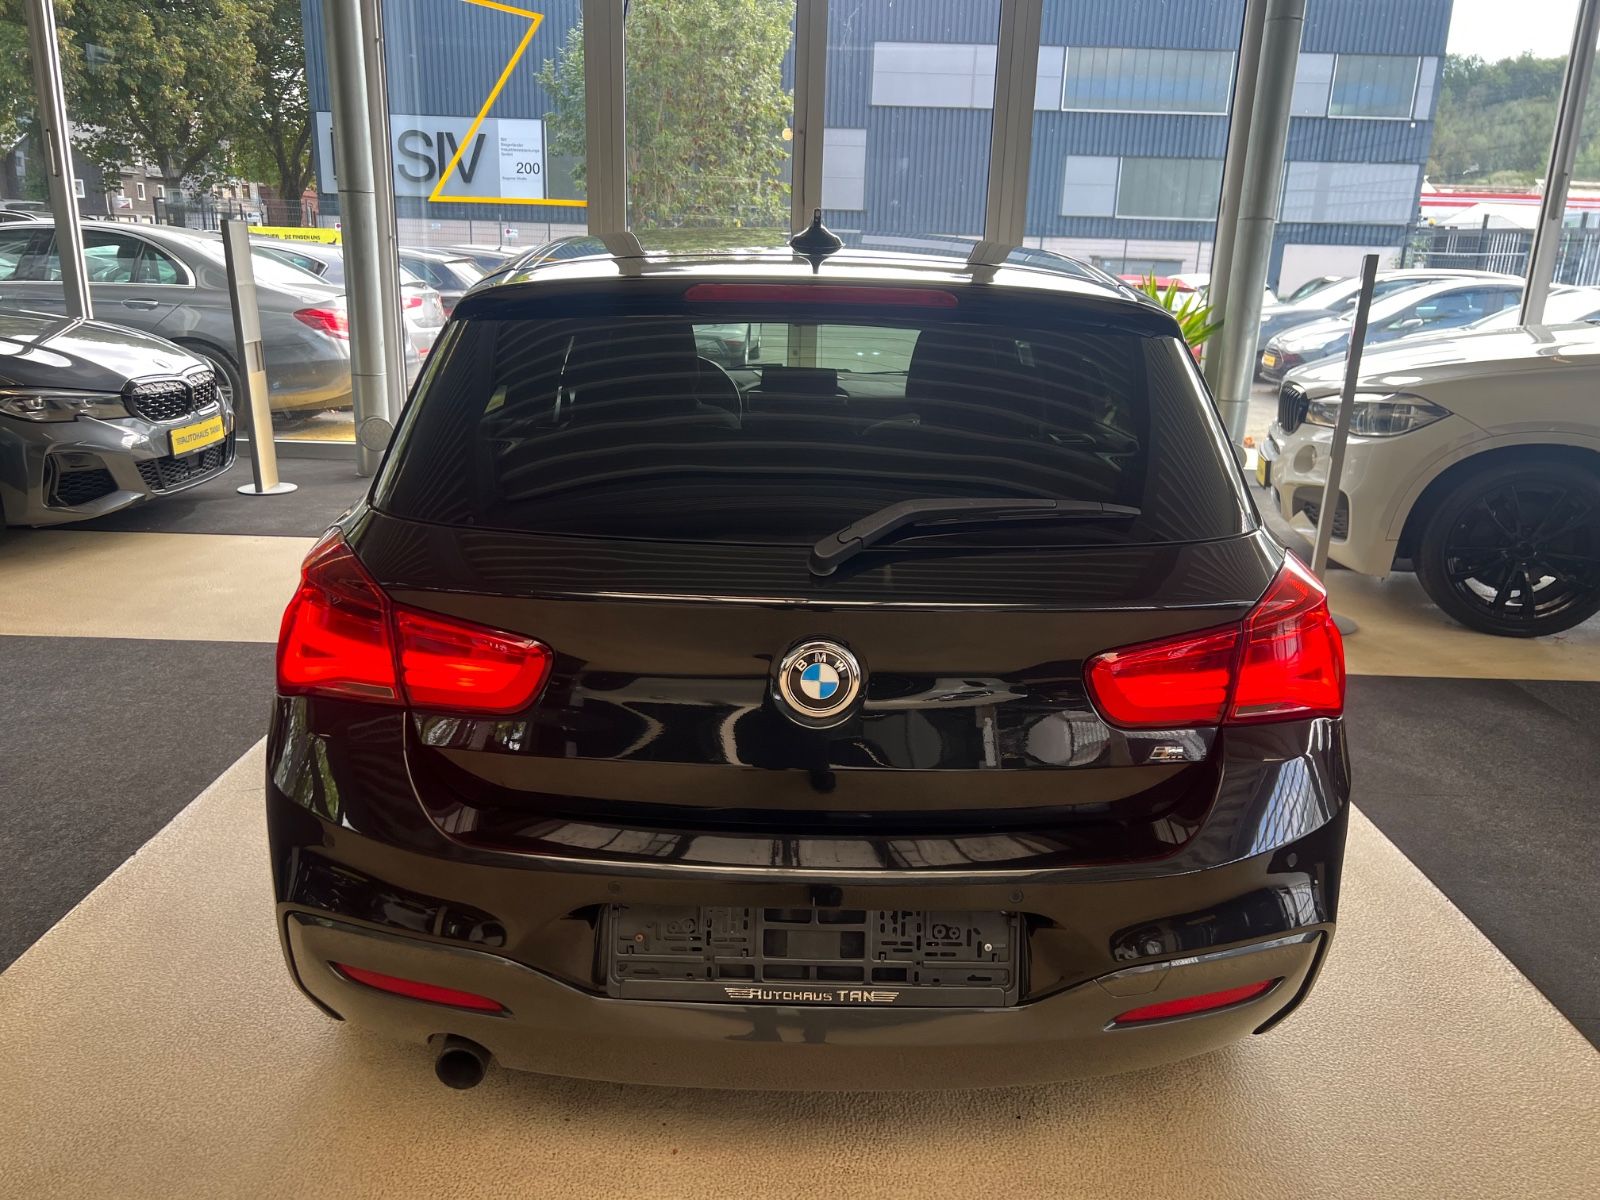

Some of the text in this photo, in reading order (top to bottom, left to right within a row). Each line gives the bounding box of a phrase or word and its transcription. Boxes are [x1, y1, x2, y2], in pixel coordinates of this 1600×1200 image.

[397, 129, 487, 184] SIV
[516, 162, 540, 175] 200
[795, 652, 847, 673] BMW
[750, 987, 875, 1002] AUTOHAUS TAN
